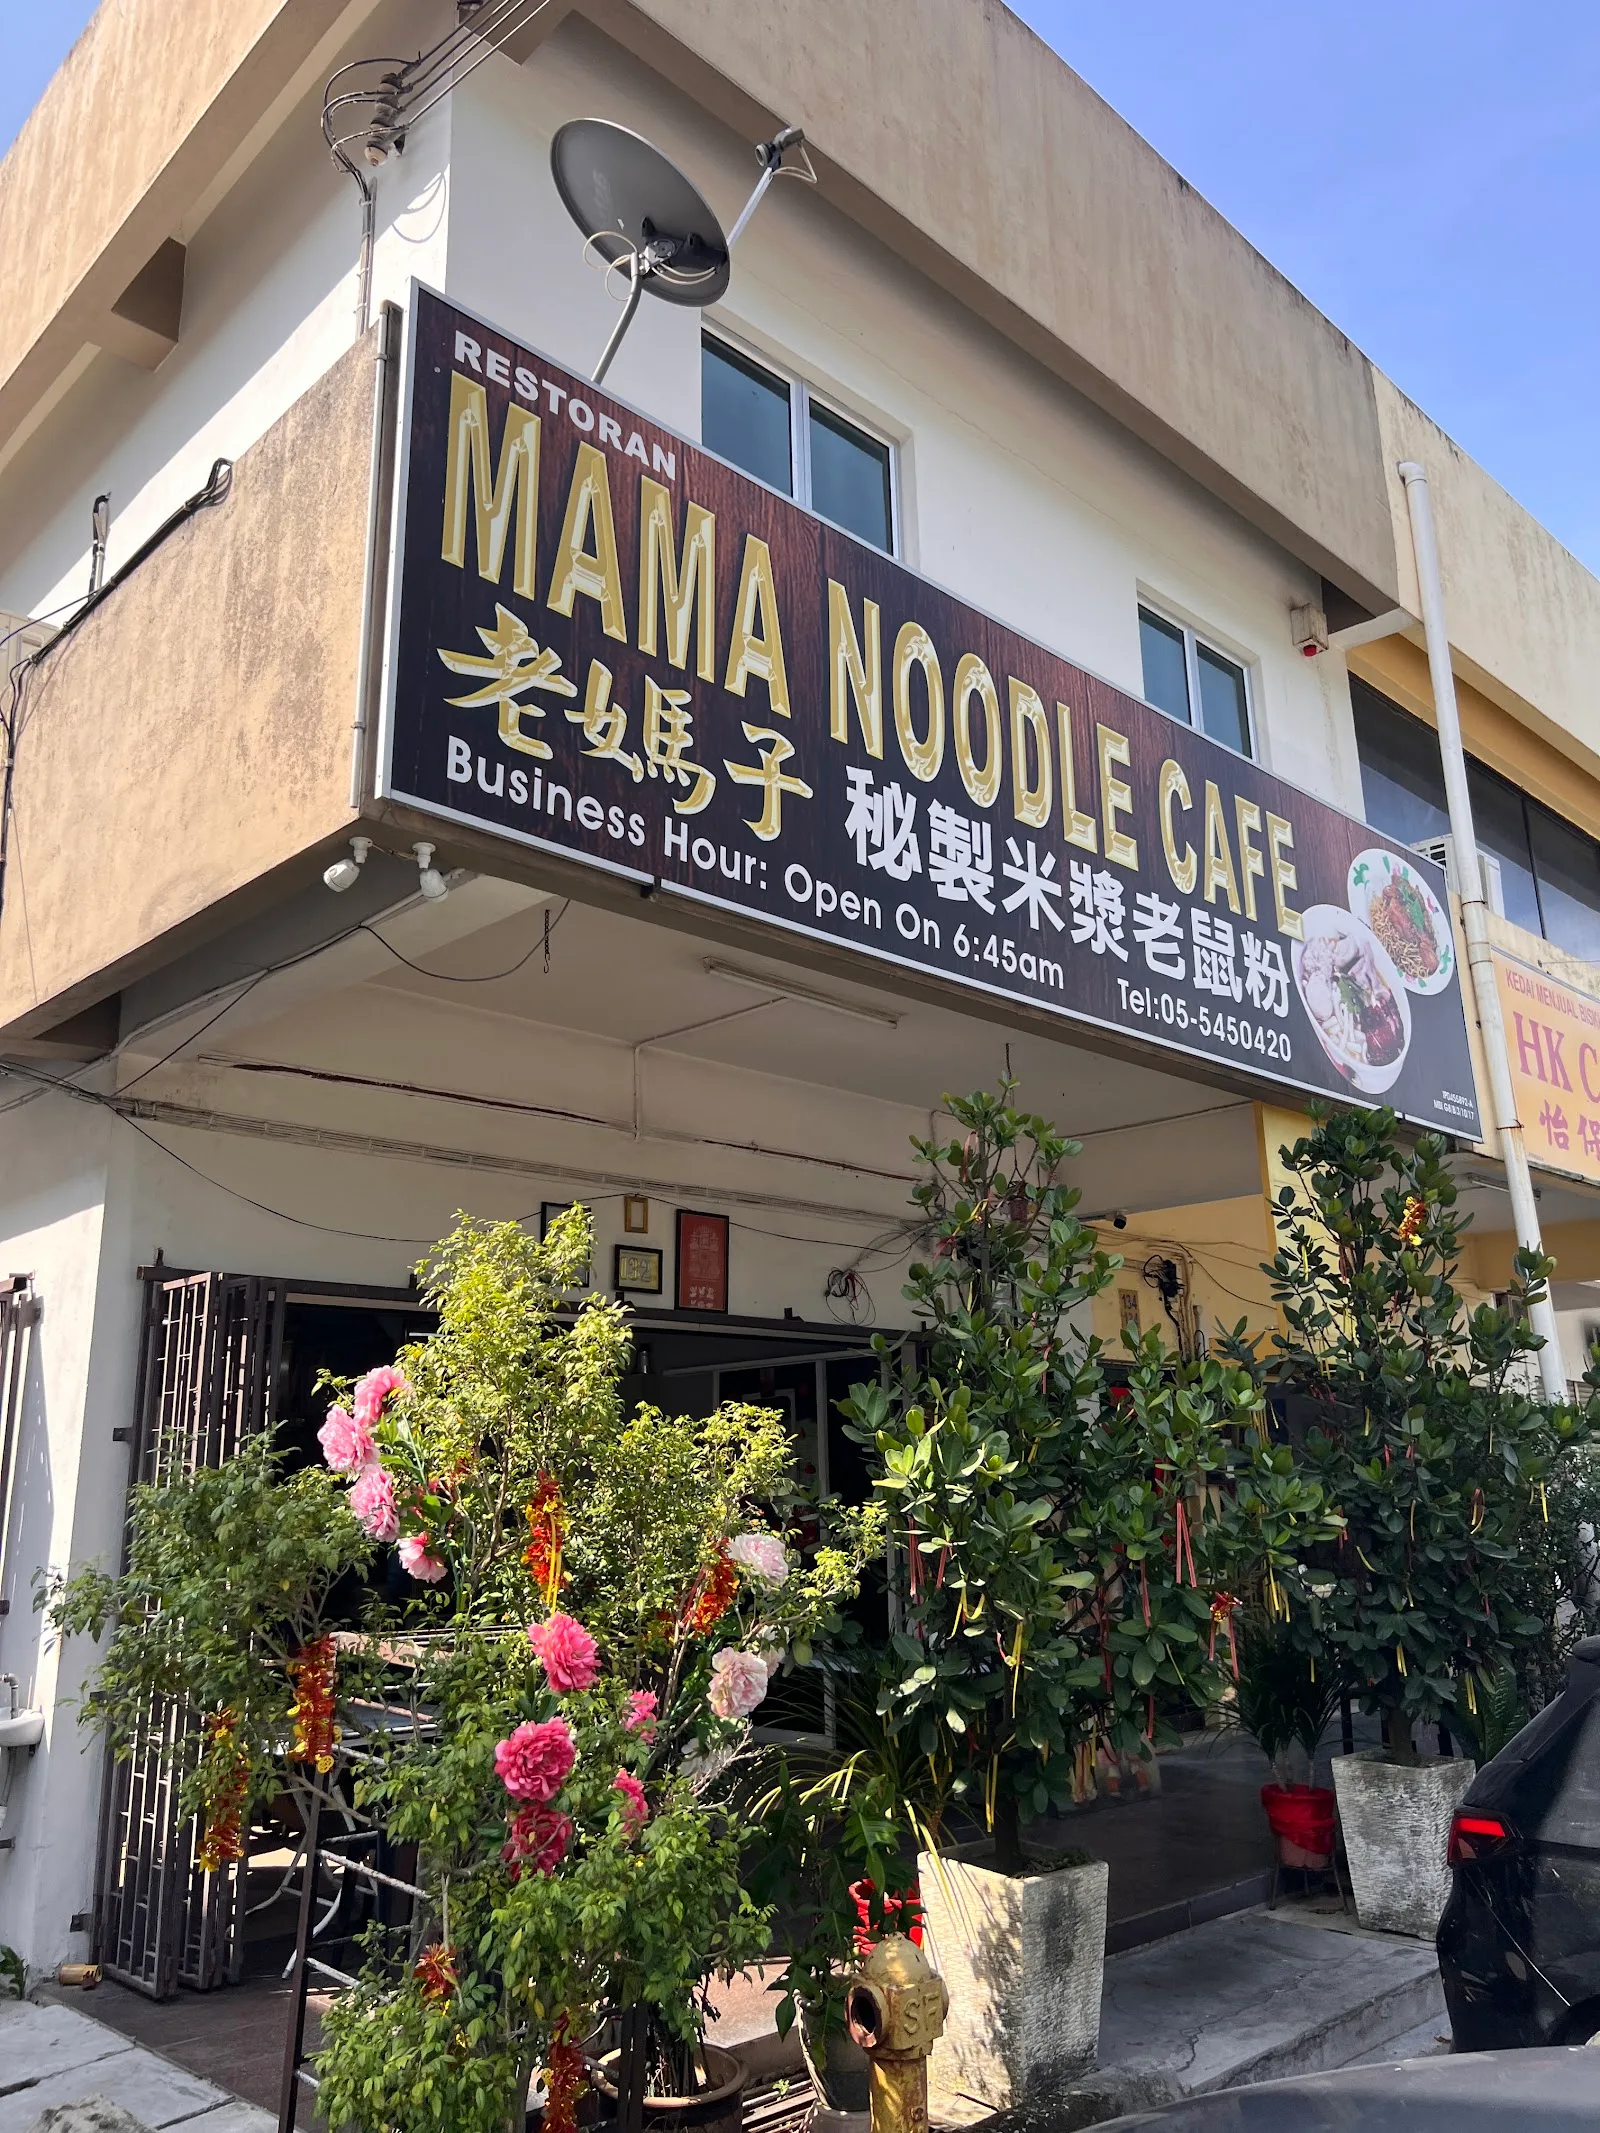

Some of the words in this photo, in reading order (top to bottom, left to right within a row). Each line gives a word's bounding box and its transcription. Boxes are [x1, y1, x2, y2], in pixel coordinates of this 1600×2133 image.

[455, 330, 676, 481] RESTORAN
[436, 602, 814, 842] 老媽子
[441, 370, 791, 718] MAMA
[828, 578, 1138, 872] NOODLE
[1159, 758, 1305, 942] CAFE
[447, 735, 645, 847] Business
[664, 816, 767, 890] Hour:
[784, 863, 882, 930] Open
[895, 903, 940, 949] On
[953, 924, 1064, 990] 6:45am
[845, 765, 1291, 1018] 秘製米漿老鼠粉
[1117, 977, 1292, 1062] Tel:05-5450420
[1505, 968, 1535, 999] KEDAI
[1536, 983, 1579, 1019] MENJUAL
[1513, 1011, 1573, 1093] HK
